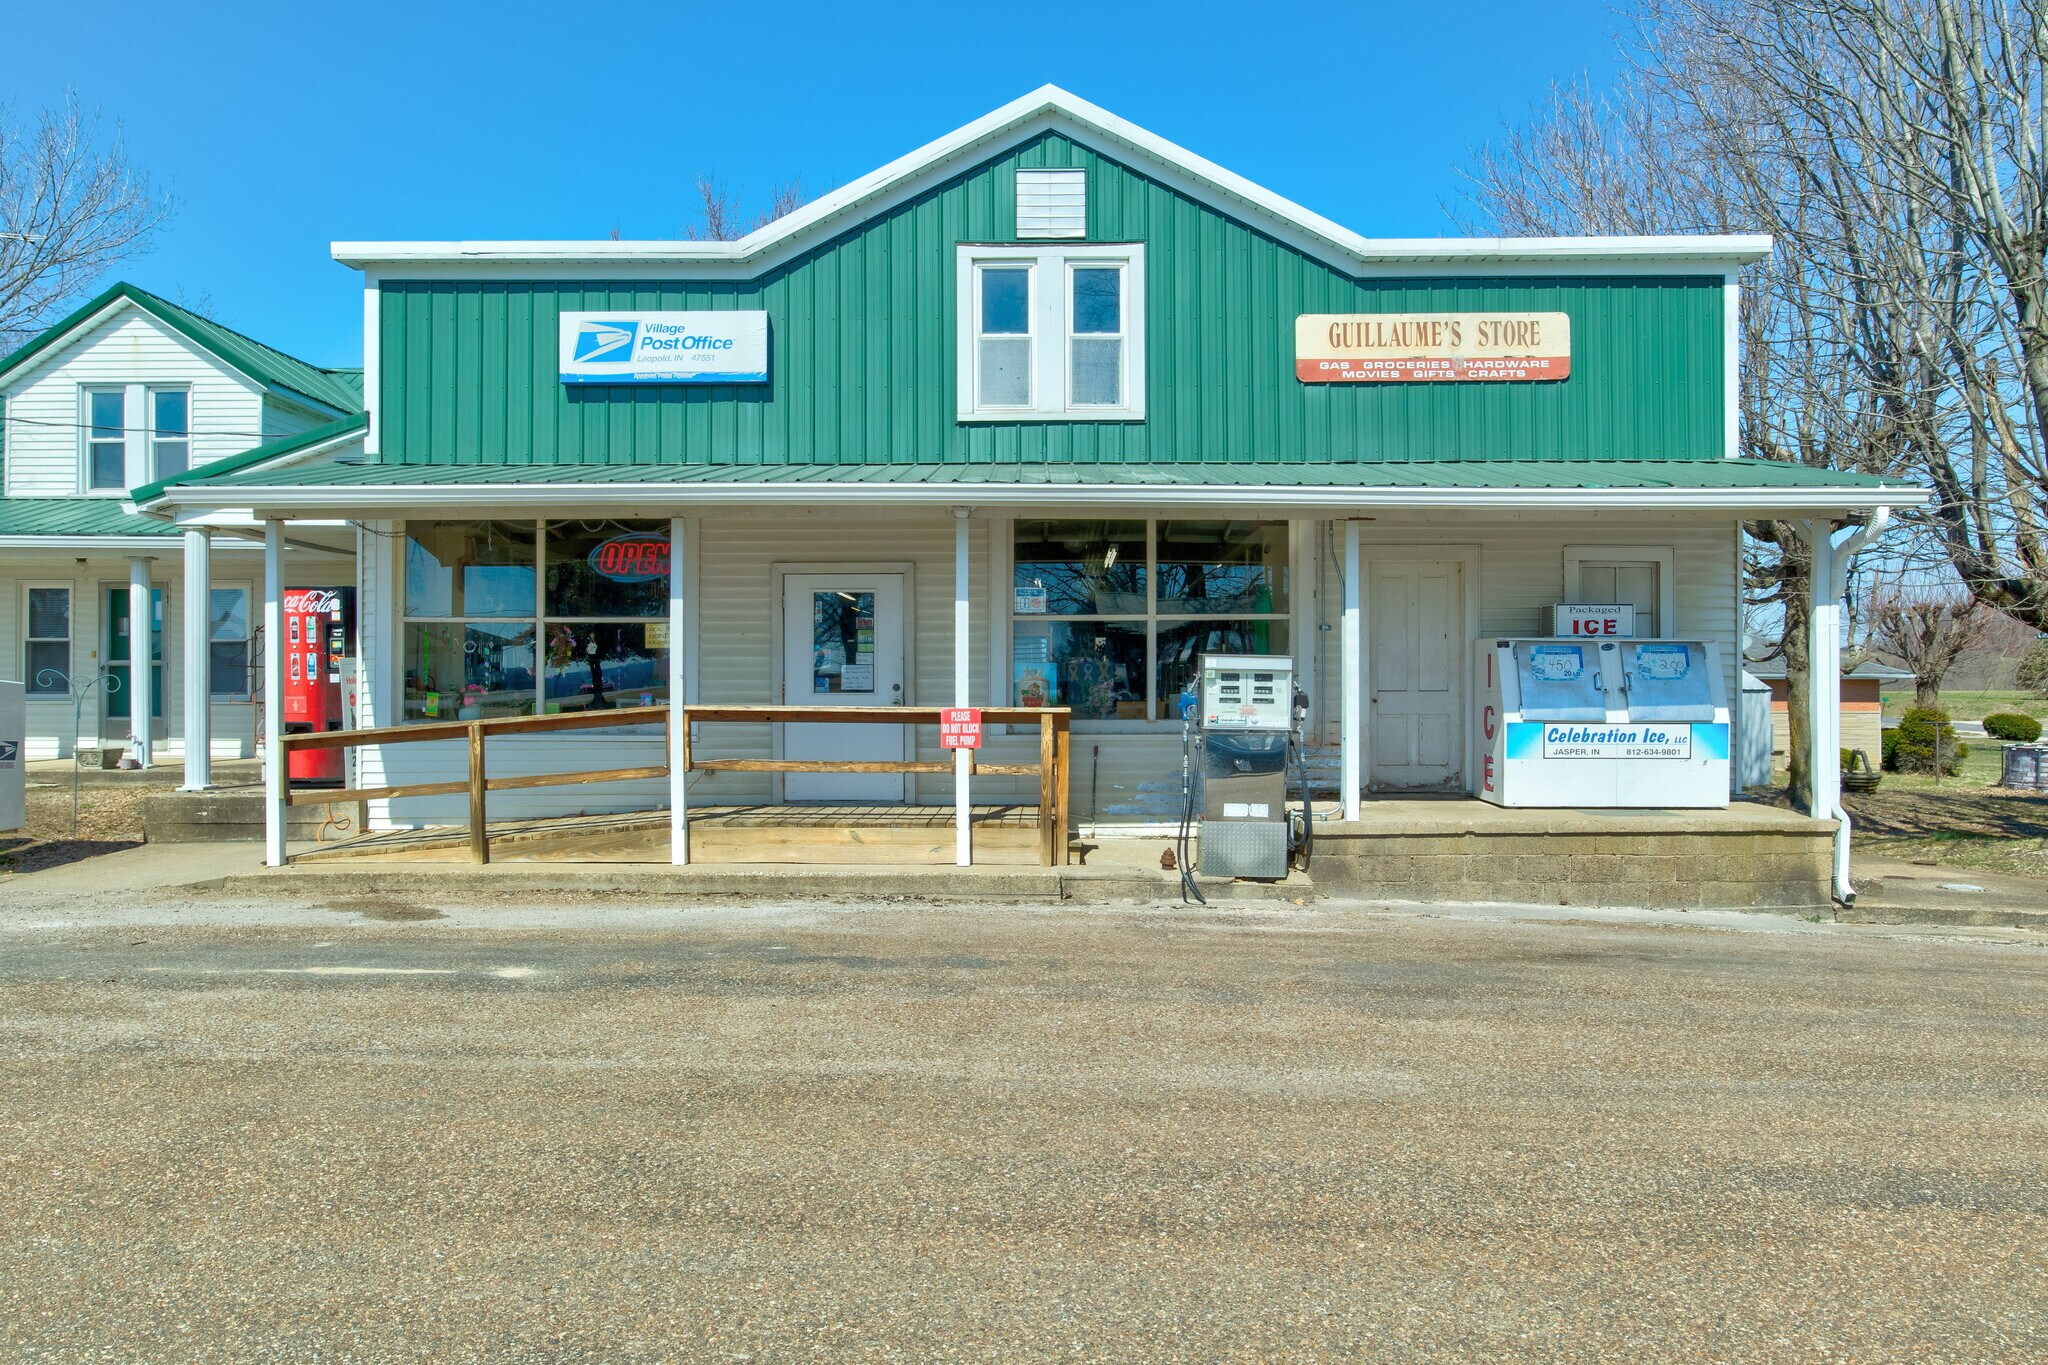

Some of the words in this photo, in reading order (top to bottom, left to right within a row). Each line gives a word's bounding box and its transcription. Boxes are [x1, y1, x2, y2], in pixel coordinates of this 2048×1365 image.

[645, 324, 685, 335] Village
[1328, 320, 1462, 348] GUILLAUME'S
[1478, 320, 1541, 348] STORE
[640, 336, 680, 350] Post
[682, 335, 733, 350] Office
[637, 354, 672, 363] Leopold,
[691, 354, 716, 362] 47551
[1319, 361, 1350, 370] GAS
[1363, 360, 1450, 370] GROCERIES
[1463, 360, 1550, 369] HARDWARE
[1342, 370, 1400, 379] MOVIES
[1413, 370, 1455, 378] GIFTS
[1468, 369, 1526, 378] CRAFTS
[600, 543, 671, 574] OPEN
[1569, 606, 1621, 614] Packaged
[1572, 618, 1617, 635] ICE
[951, 711, 971, 721] PLEASE
[942, 723, 950, 733] DO
[950, 723, 961, 733] NOT
[962, 723, 980, 733] BLOCK
[945, 735, 959, 746] FUEL
[960, 735, 976, 746] PUMP
[1547, 727, 1637, 743] Celebration
[1642, 728, 1670, 745] Ice,
[1674, 736, 1688, 744] LLC
[1553, 748, 1589, 756] JASPER,
[1591, 748, 1600, 756] IN
[1626, 748, 1681, 756] 812-634-9801
